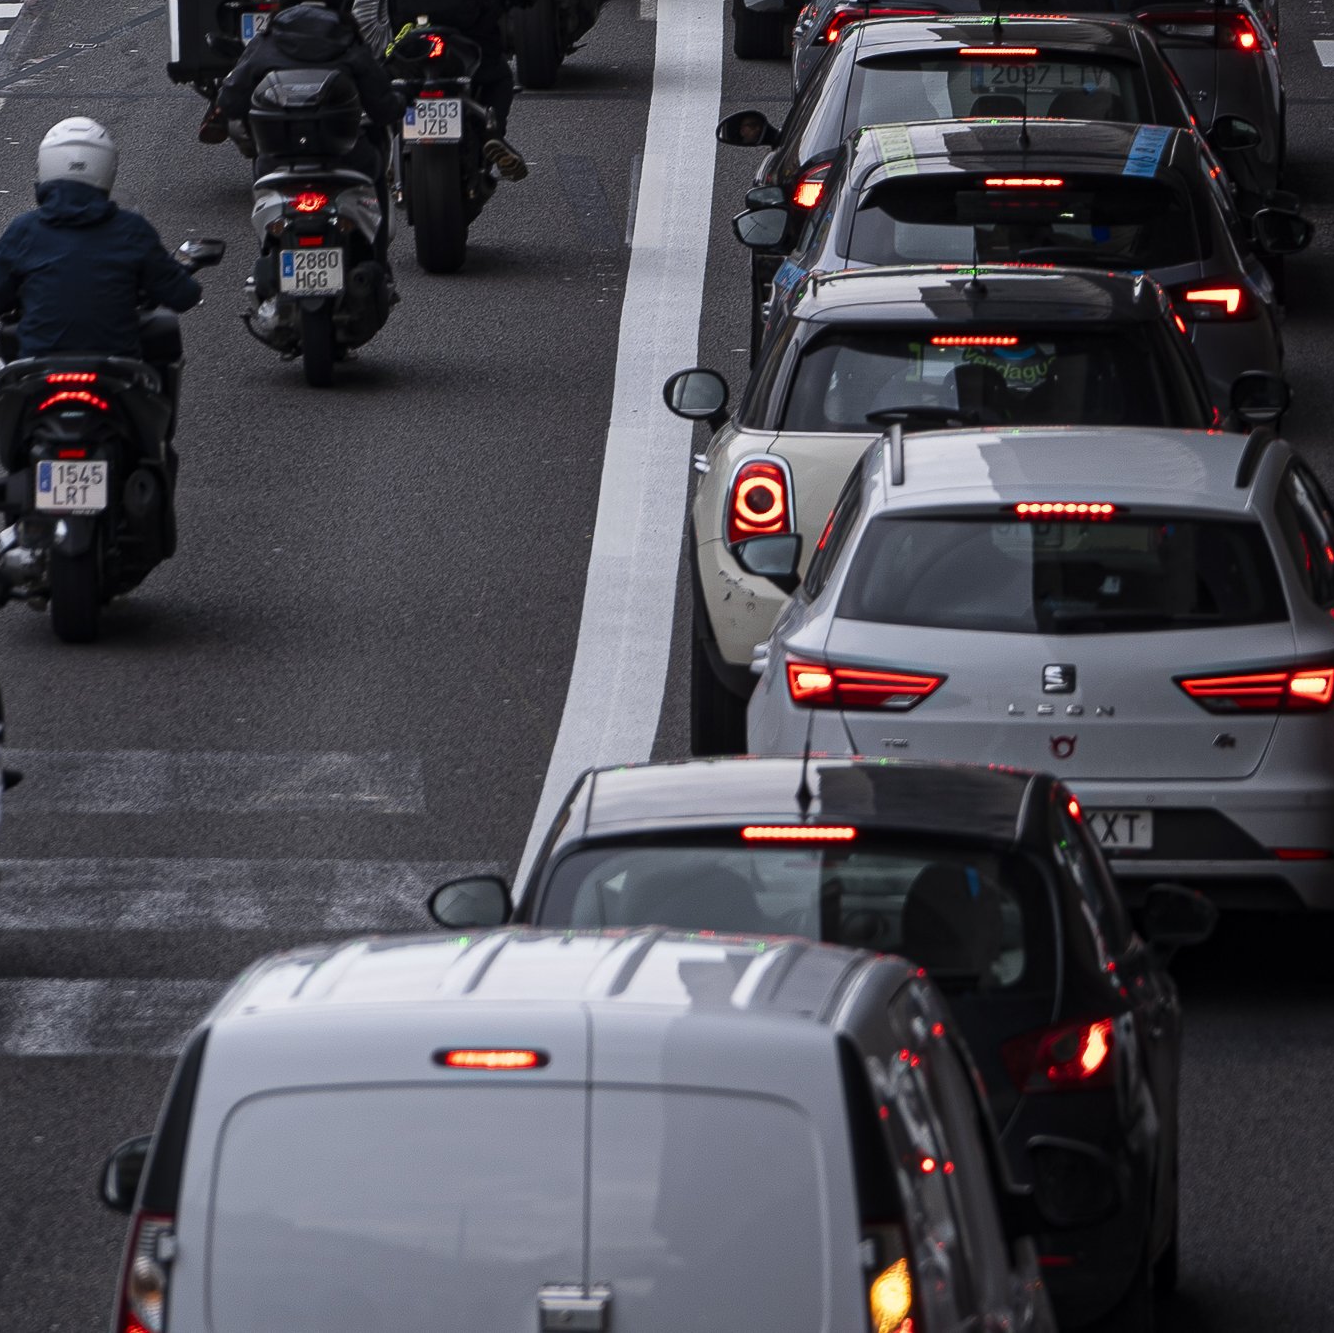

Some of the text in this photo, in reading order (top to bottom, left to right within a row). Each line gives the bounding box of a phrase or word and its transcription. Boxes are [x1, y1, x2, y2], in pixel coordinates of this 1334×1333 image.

[417, 102, 458, 119] 8503
[417, 119, 448, 136] JZB
[295, 251, 339, 271] 2880
[295, 271, 328, 289] HGG
[57, 464, 103, 485] 1545
[53, 485, 90, 505] LRT
[1008, 703, 1116, 717] LEON
